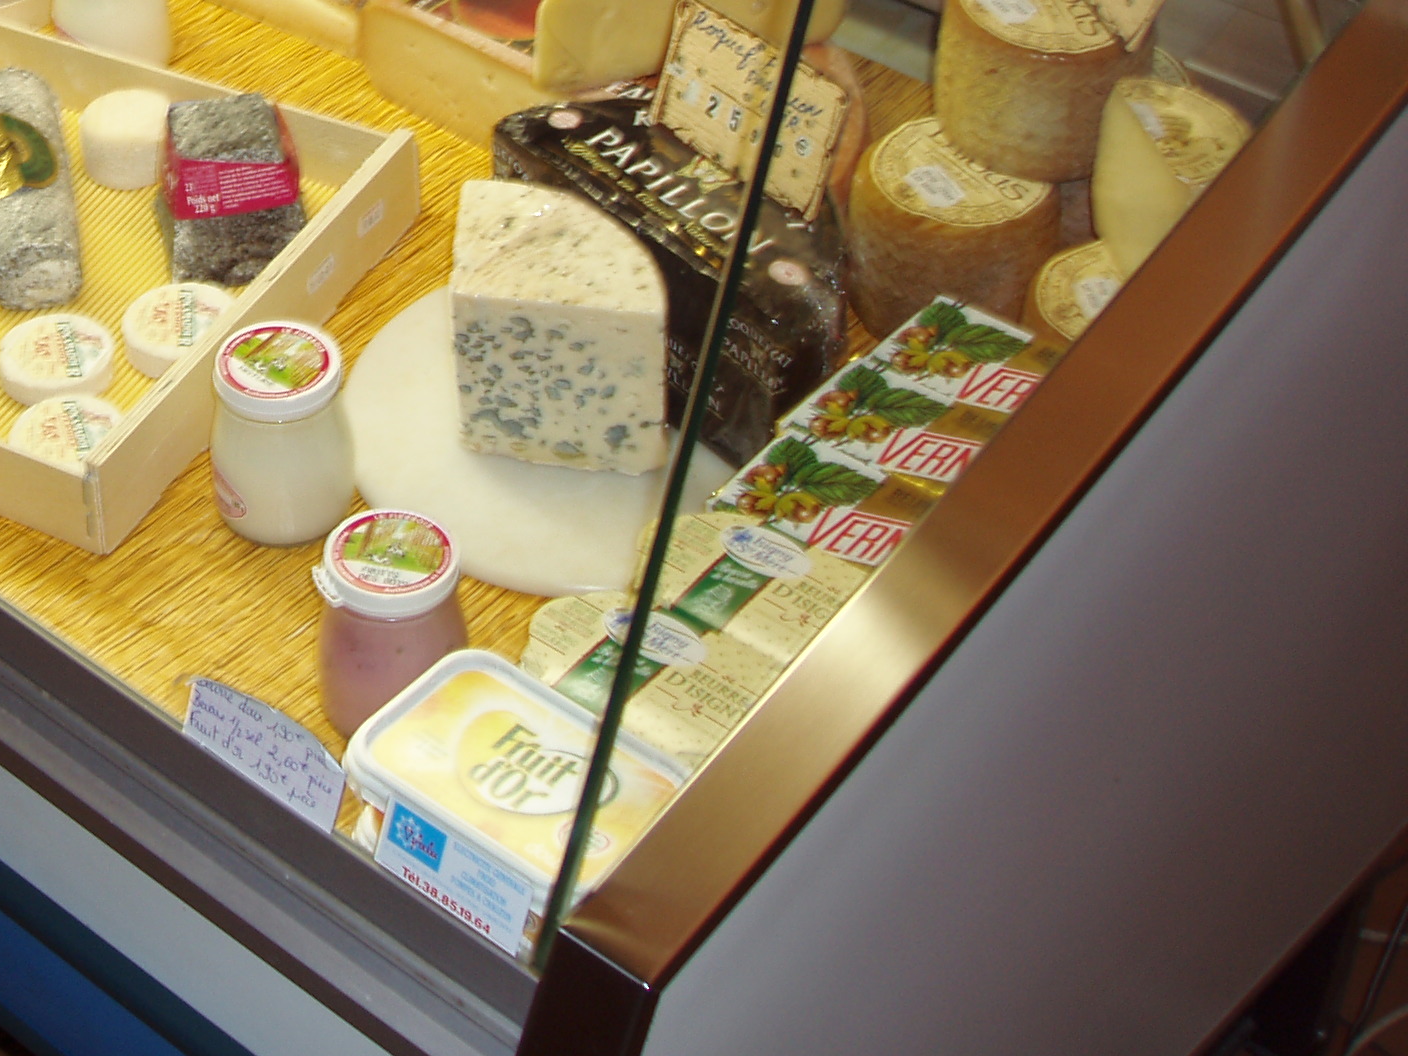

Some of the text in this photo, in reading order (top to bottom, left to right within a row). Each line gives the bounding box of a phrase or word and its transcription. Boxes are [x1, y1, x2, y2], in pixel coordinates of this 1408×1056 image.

[586, 125, 774, 256] PAPILLON
[771, 582, 831, 621] D'ISIG
[468, 758, 550, 809] d'Or
[491, 722, 580, 788] Fruit
